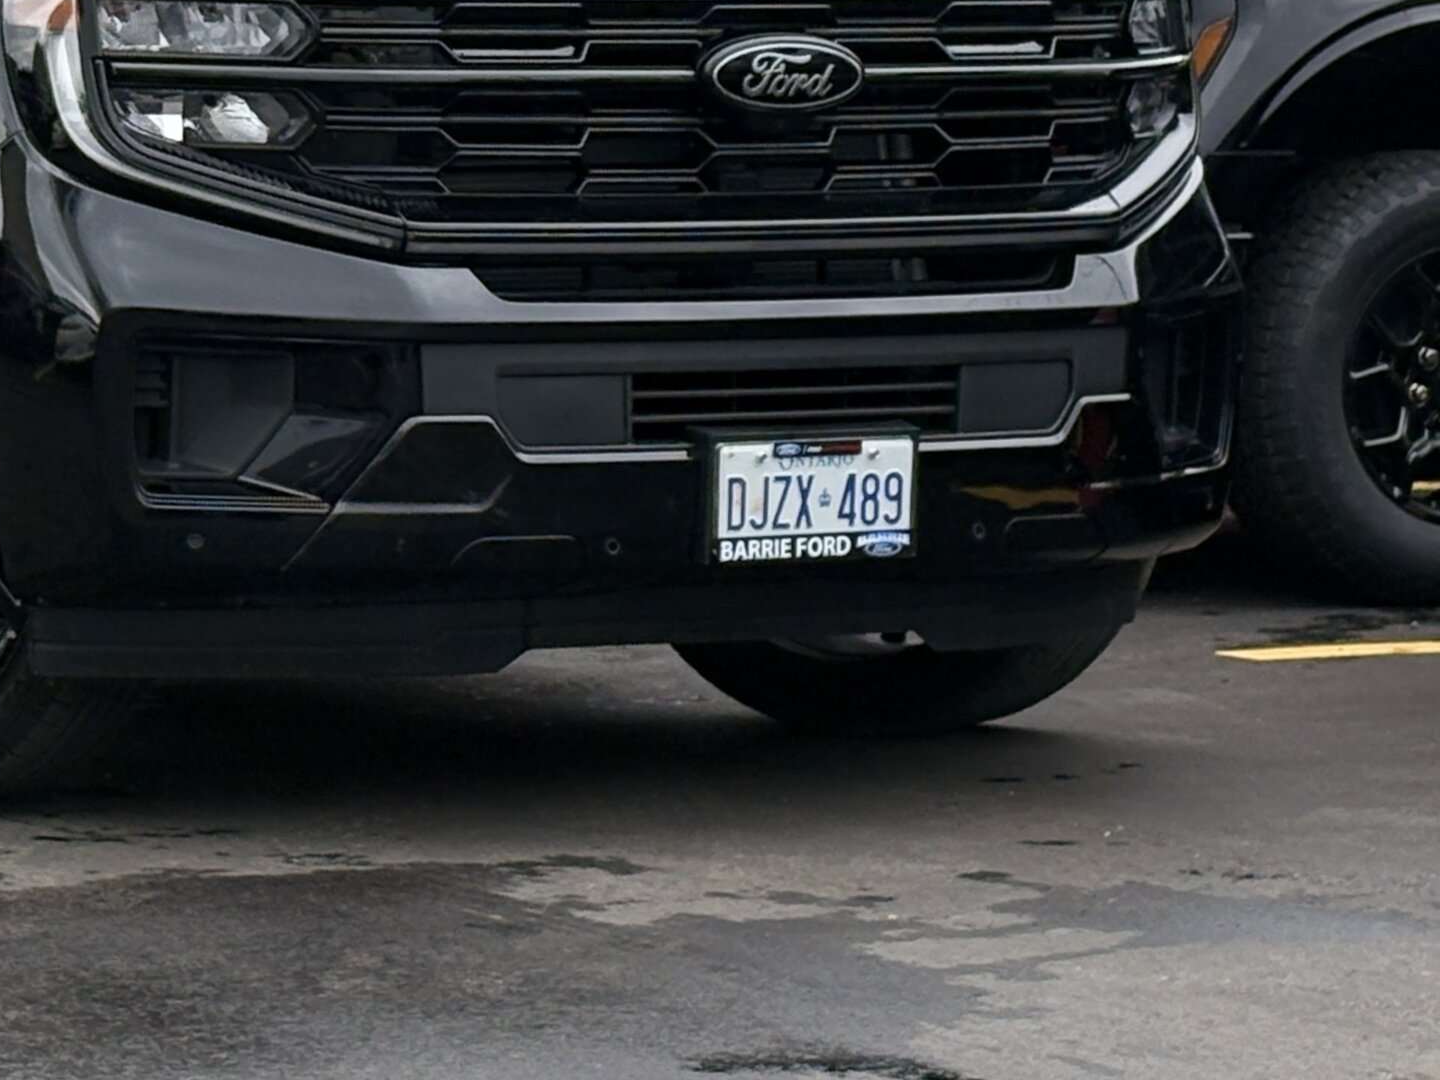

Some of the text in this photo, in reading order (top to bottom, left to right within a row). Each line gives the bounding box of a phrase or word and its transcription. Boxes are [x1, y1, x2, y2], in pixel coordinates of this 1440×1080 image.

[742, 52, 836, 97] Ford
[726, 472, 904, 531] DJZX 489
[719, 539, 793, 562] BARRIE
[795, 535, 852, 558] FORD
